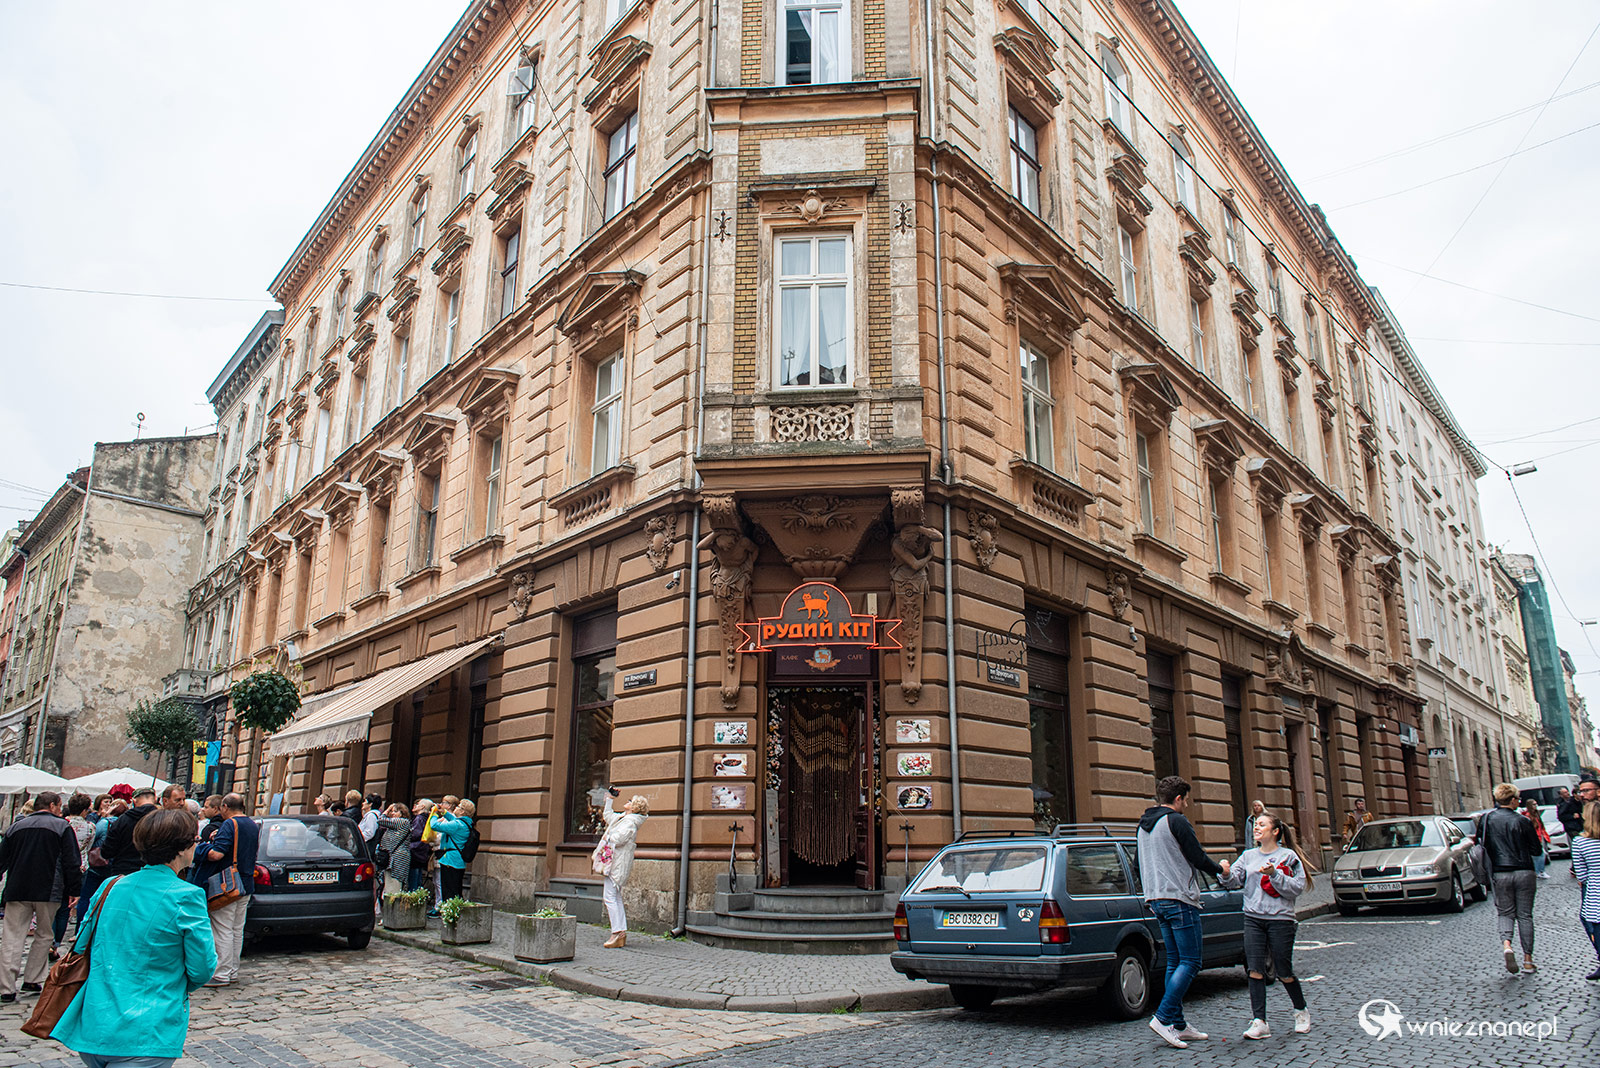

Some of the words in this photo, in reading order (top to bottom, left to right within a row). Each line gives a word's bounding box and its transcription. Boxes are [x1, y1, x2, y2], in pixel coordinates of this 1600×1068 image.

[763, 619, 833, 640] РУДИЙ
[838, 622, 871, 638] КІТ
[293, 872, 305, 881] BC
[306, 872, 324, 881] 2266
[962, 913, 982, 924] 0382
